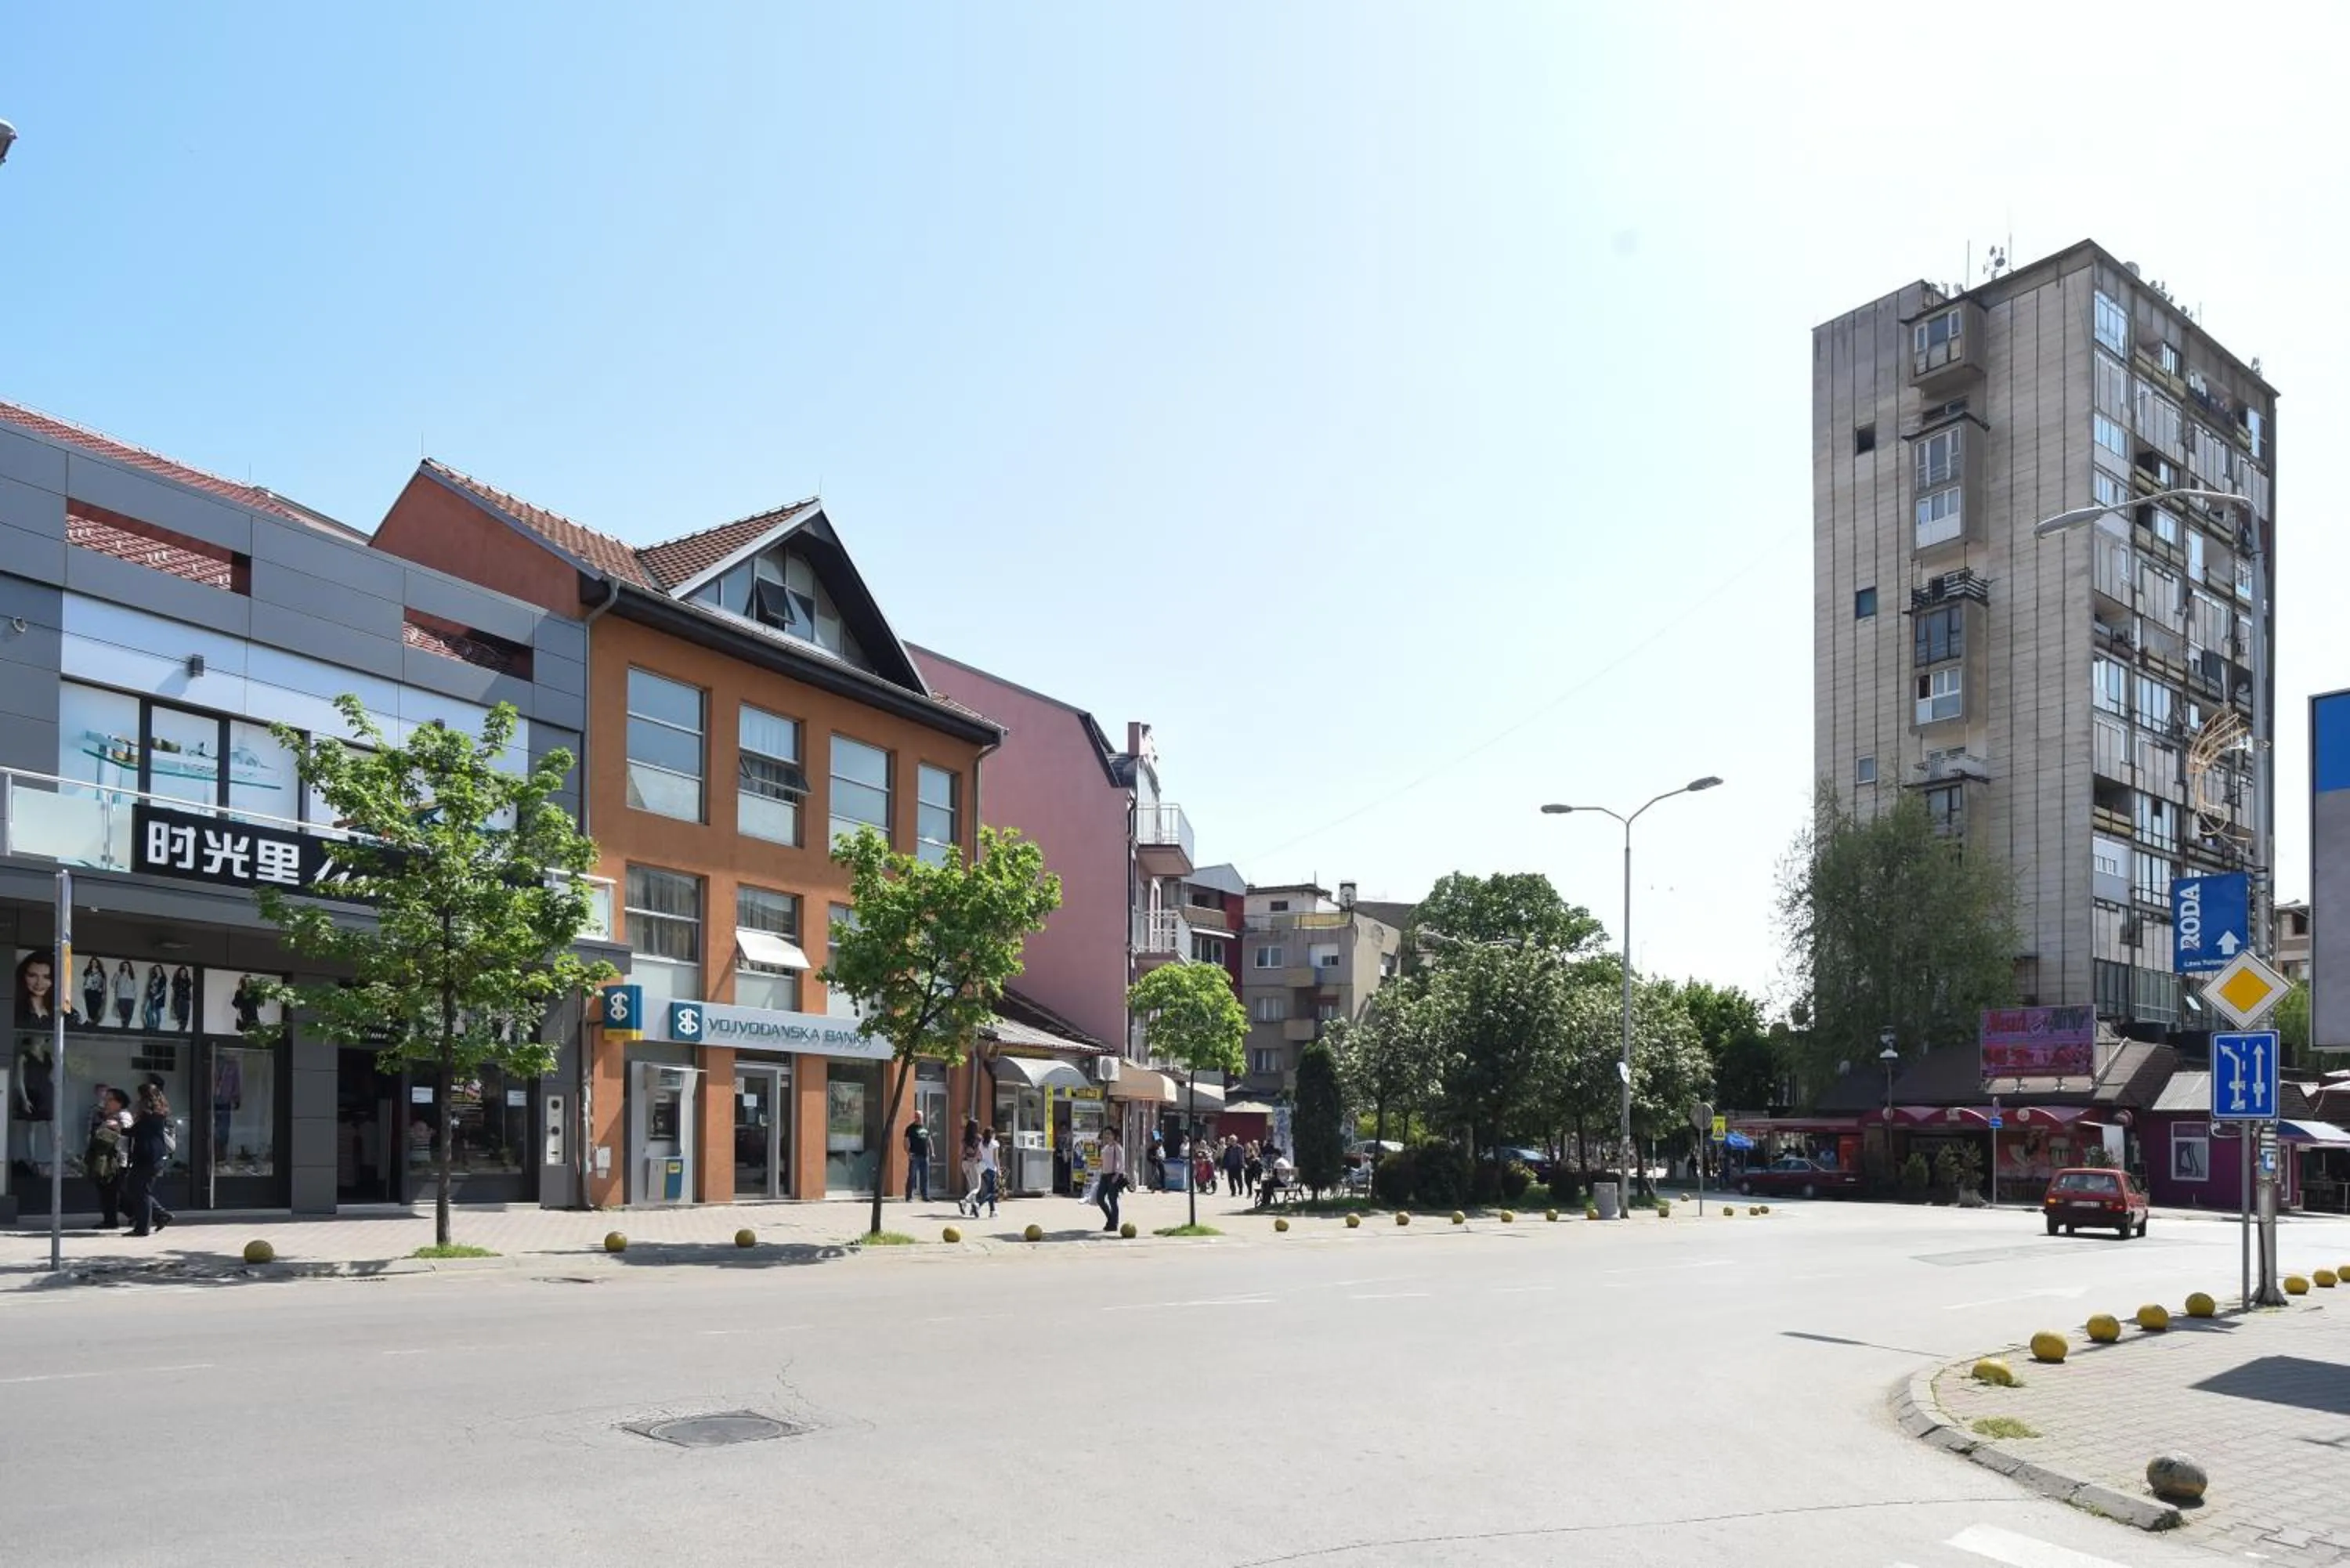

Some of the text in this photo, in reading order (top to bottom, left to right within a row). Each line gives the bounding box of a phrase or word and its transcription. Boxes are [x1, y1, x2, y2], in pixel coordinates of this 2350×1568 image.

[146, 820, 301, 886] 时光里
[2179, 883, 2200, 952] RODA
